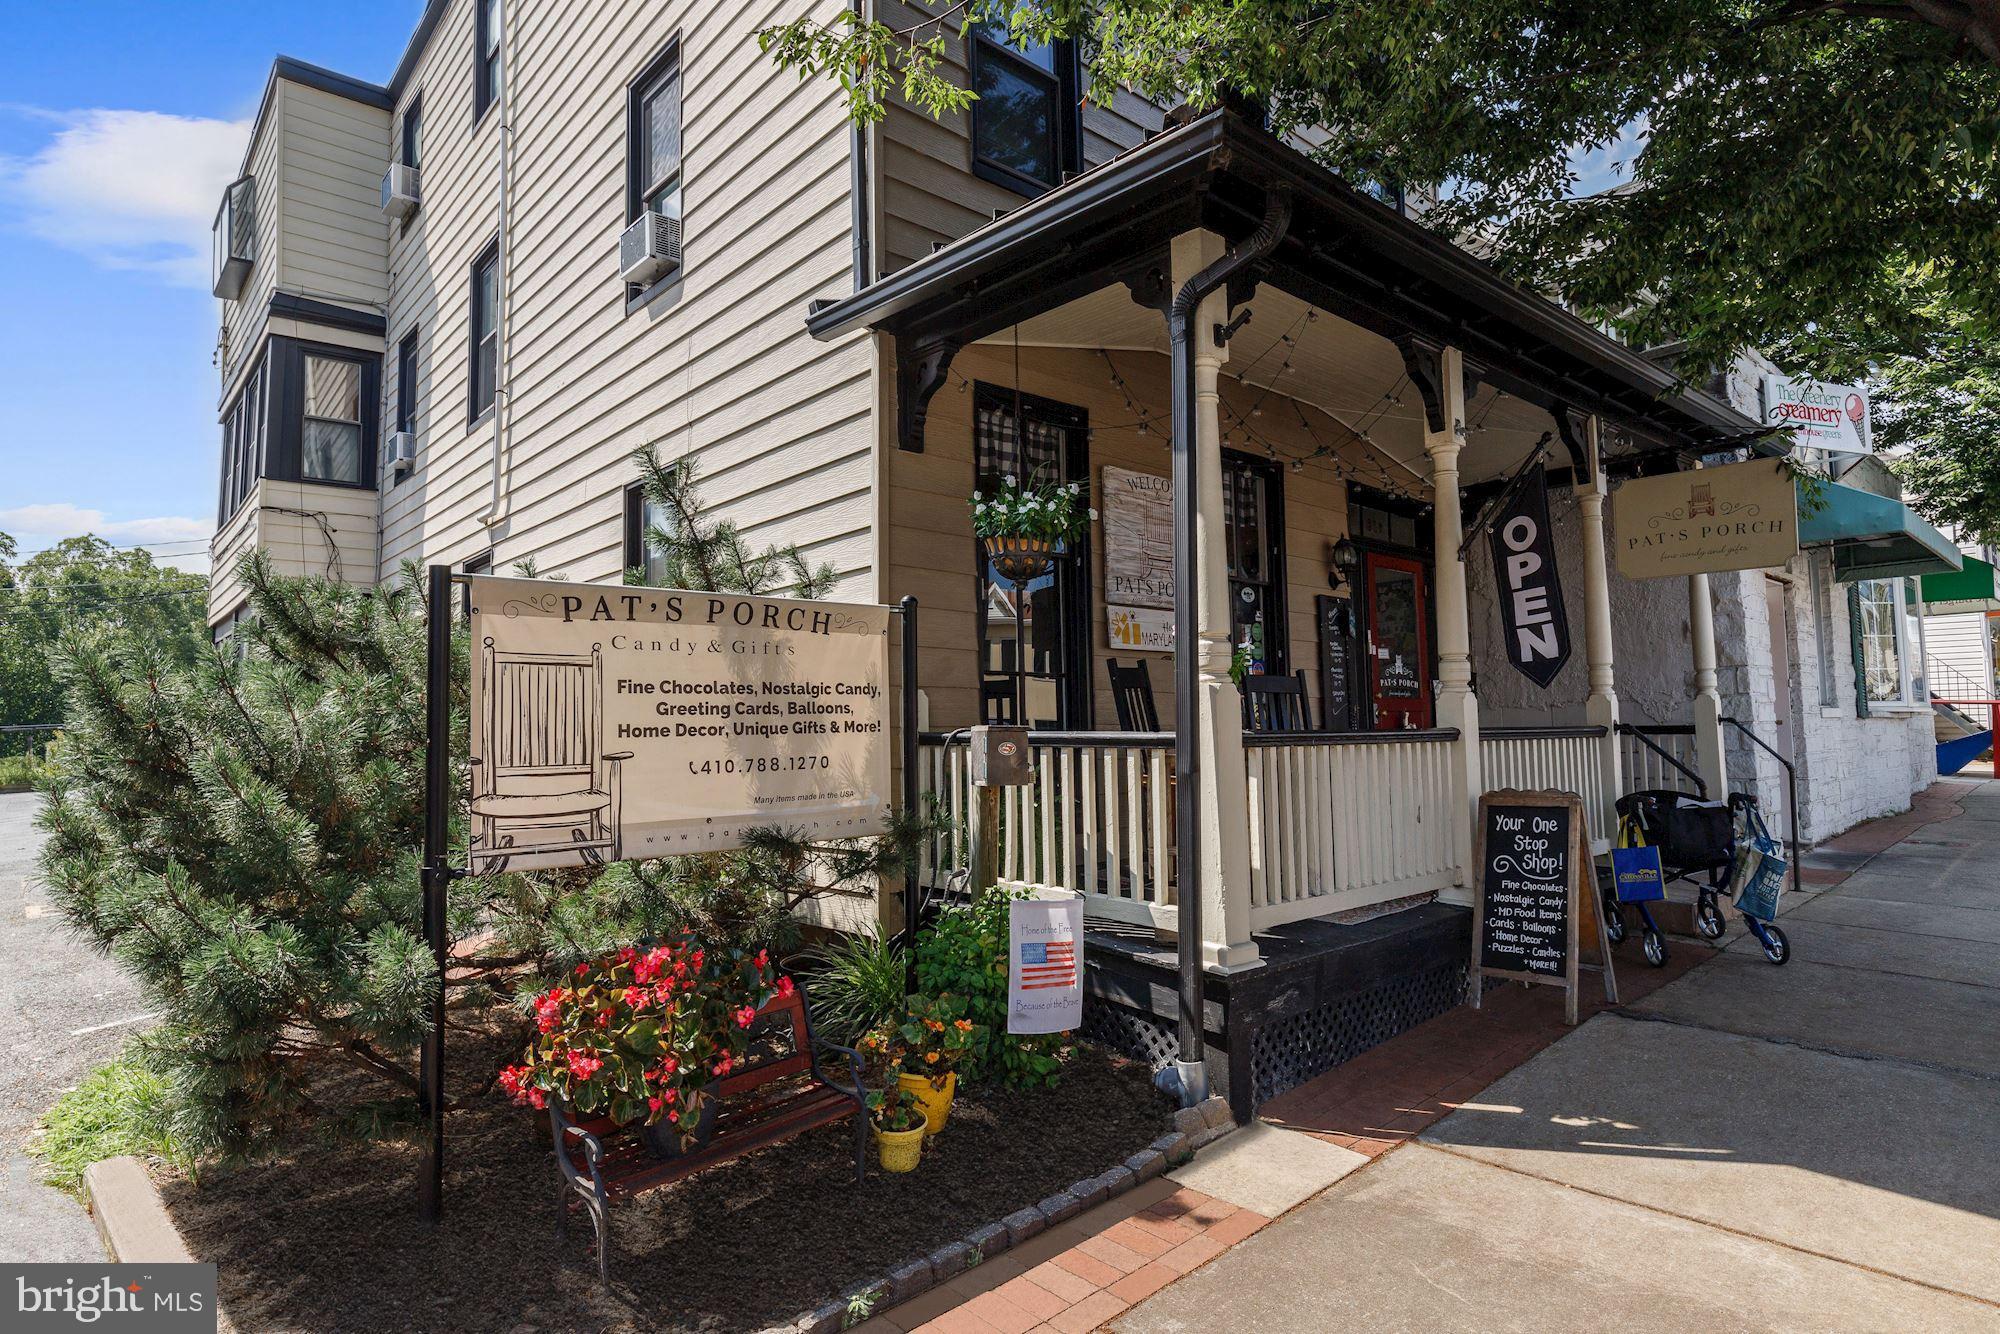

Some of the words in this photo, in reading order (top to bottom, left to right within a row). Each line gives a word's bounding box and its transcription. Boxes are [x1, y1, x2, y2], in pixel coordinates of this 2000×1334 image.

[1776, 384, 1795, 400] The
[1797, 388, 1840, 407] Greenery
[1127, 476, 1171, 492] WELCO
[1702, 520, 1783, 538] PORCH
[1502, 515, 1560, 663] OPEN
[561, 595, 683, 623] PAT'S
[706, 599, 832, 635] PORCH
[611, 635, 697, 655] Candy
[707, 639, 721, 653] &
[732, 640, 795, 655] Gifts
[1142, 632, 1174, 647] MARYLA
[617, 679, 655, 694] Fine
[659, 680, 758, 697] Chocolates,
[762, 681, 832, 699] Nostalgic
[835, 682, 881, 699] Candy,
[1399, 680, 1418, 688] PORCH
[656, 701, 731, 719] Greeting
[735, 701, 784, 717] Cards,
[787, 701, 854, 716] Balloons,
[617, 723, 671, 738] Home
[675, 723, 730, 738] Decor,
[733, 721, 788, 738] Unique
[792, 721, 826, 735] Gifts
[830, 720, 841, 733] &
[844, 720, 881, 733] More!
[700, 756, 829, 774] 410.788.1270
[753, 796, 775, 804] Many
[775, 795, 796, 803] items
[798, 793, 817, 801] made
[827, 791, 837, 799] the
[839, 790, 854, 798] USA
[1496, 815, 1525, 832] Your
[1532, 817, 1558, 834] One
[1514, 835, 1548, 857] Stop
[1522, 853, 1563, 875] Shop!
[1502, 880, 1520, 889] Fine
[1522, 881, 1563, 893] Chocolates
[1763, 877, 1780, 889] BAG
[1493, 892, 1535, 907] Nostalgic
[1539, 896, 1564, 909] Candy
[1498, 907, 1512, 916] MD
[1514, 908, 1536, 918] Food
[1539, 911, 1562, 920] Items
[1021, 924, 1039, 936] Home
[1041, 923, 1048, 934] of
[1048, 923, 1057, 934] the
[1059, 923, 1073, 933] Free
[1489, 918, 1515, 929] Cards
[1522, 922, 1556, 934] Balloons
[1495, 930, 1518, 943] Home
[1520, 934, 1543, 944] Decor
[1492, 943, 1524, 954] Puzzles
[1532, 947, 1560, 958] Candles
[1016, 999, 1045, 1011] Because
[1046, 998, 1053, 1010] of
[1053, 998, 1062, 1008] the
[1063, 997, 1079, 1009] Brave
